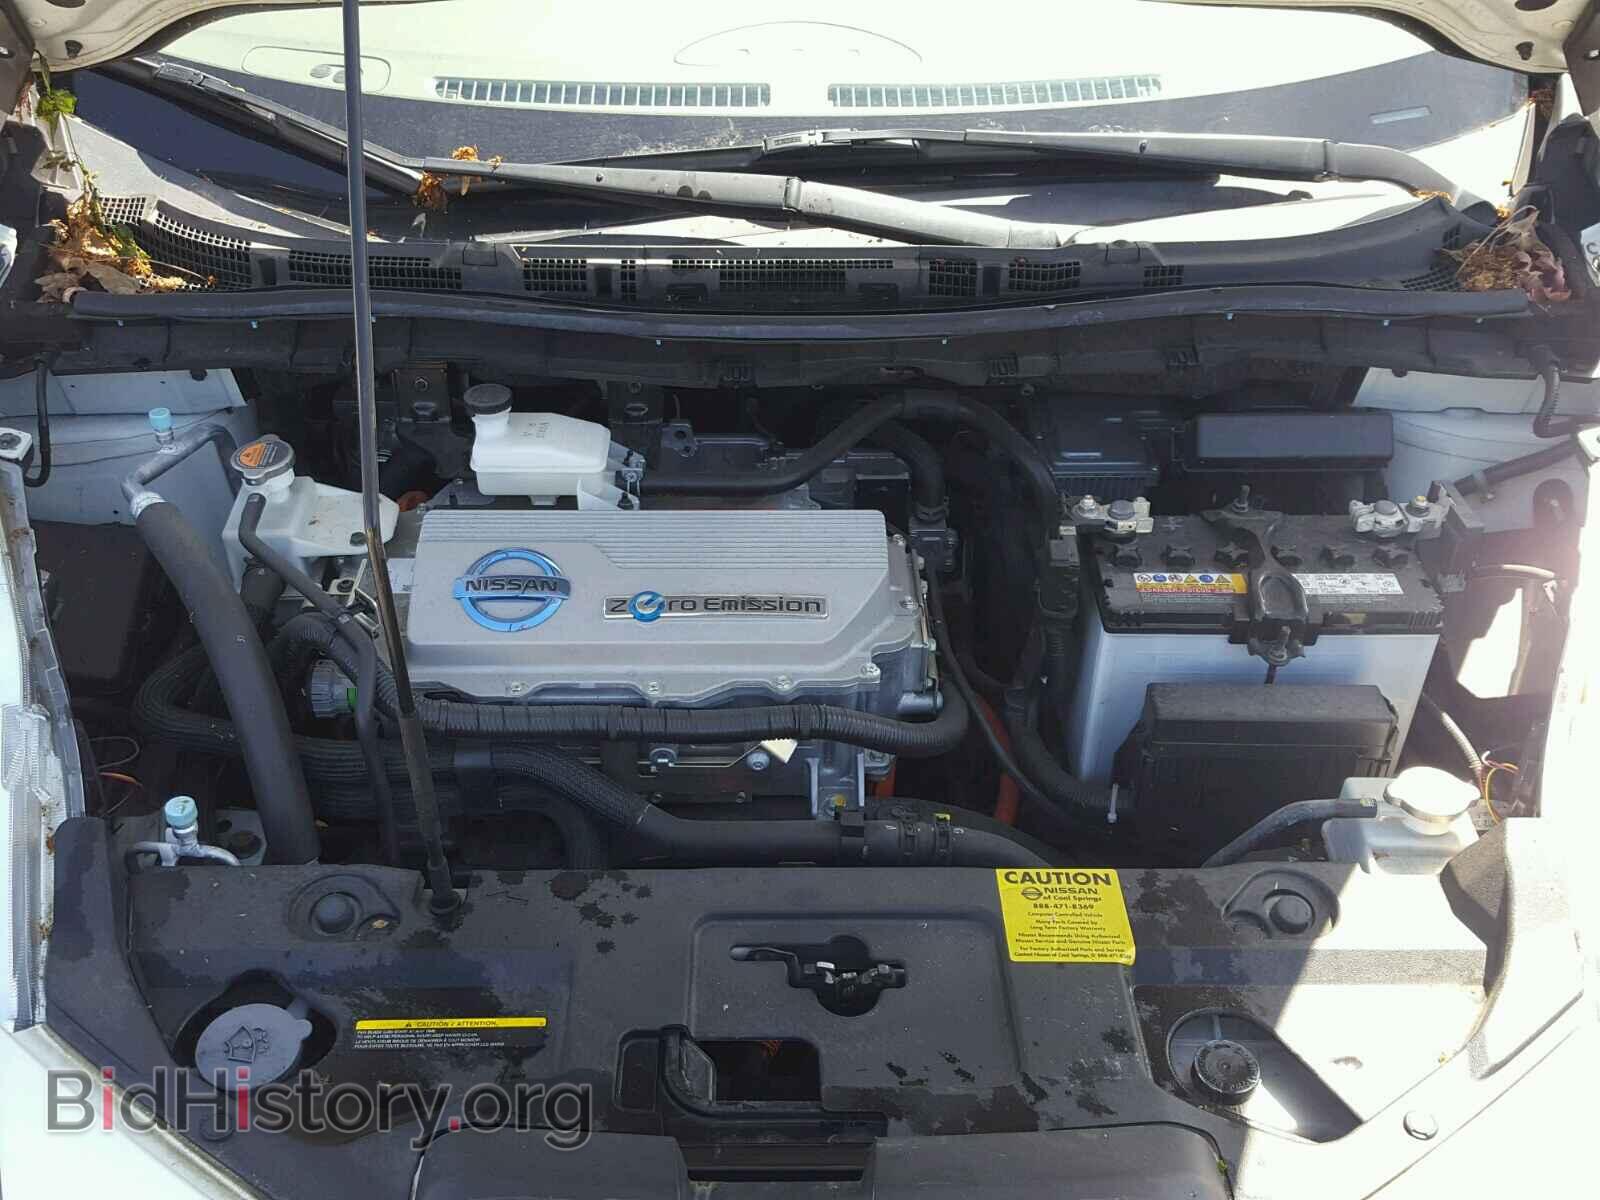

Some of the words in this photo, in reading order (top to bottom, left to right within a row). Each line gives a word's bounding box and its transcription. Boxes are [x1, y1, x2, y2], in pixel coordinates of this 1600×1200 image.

[464, 577, 558, 593] NISSAN
[702, 595, 822, 614] Emission
[1004, 870, 1112, 886] CAUTION
[1044, 887, 1098, 895] NISSAN
[416, 1020, 449, 1028] CAUTION
